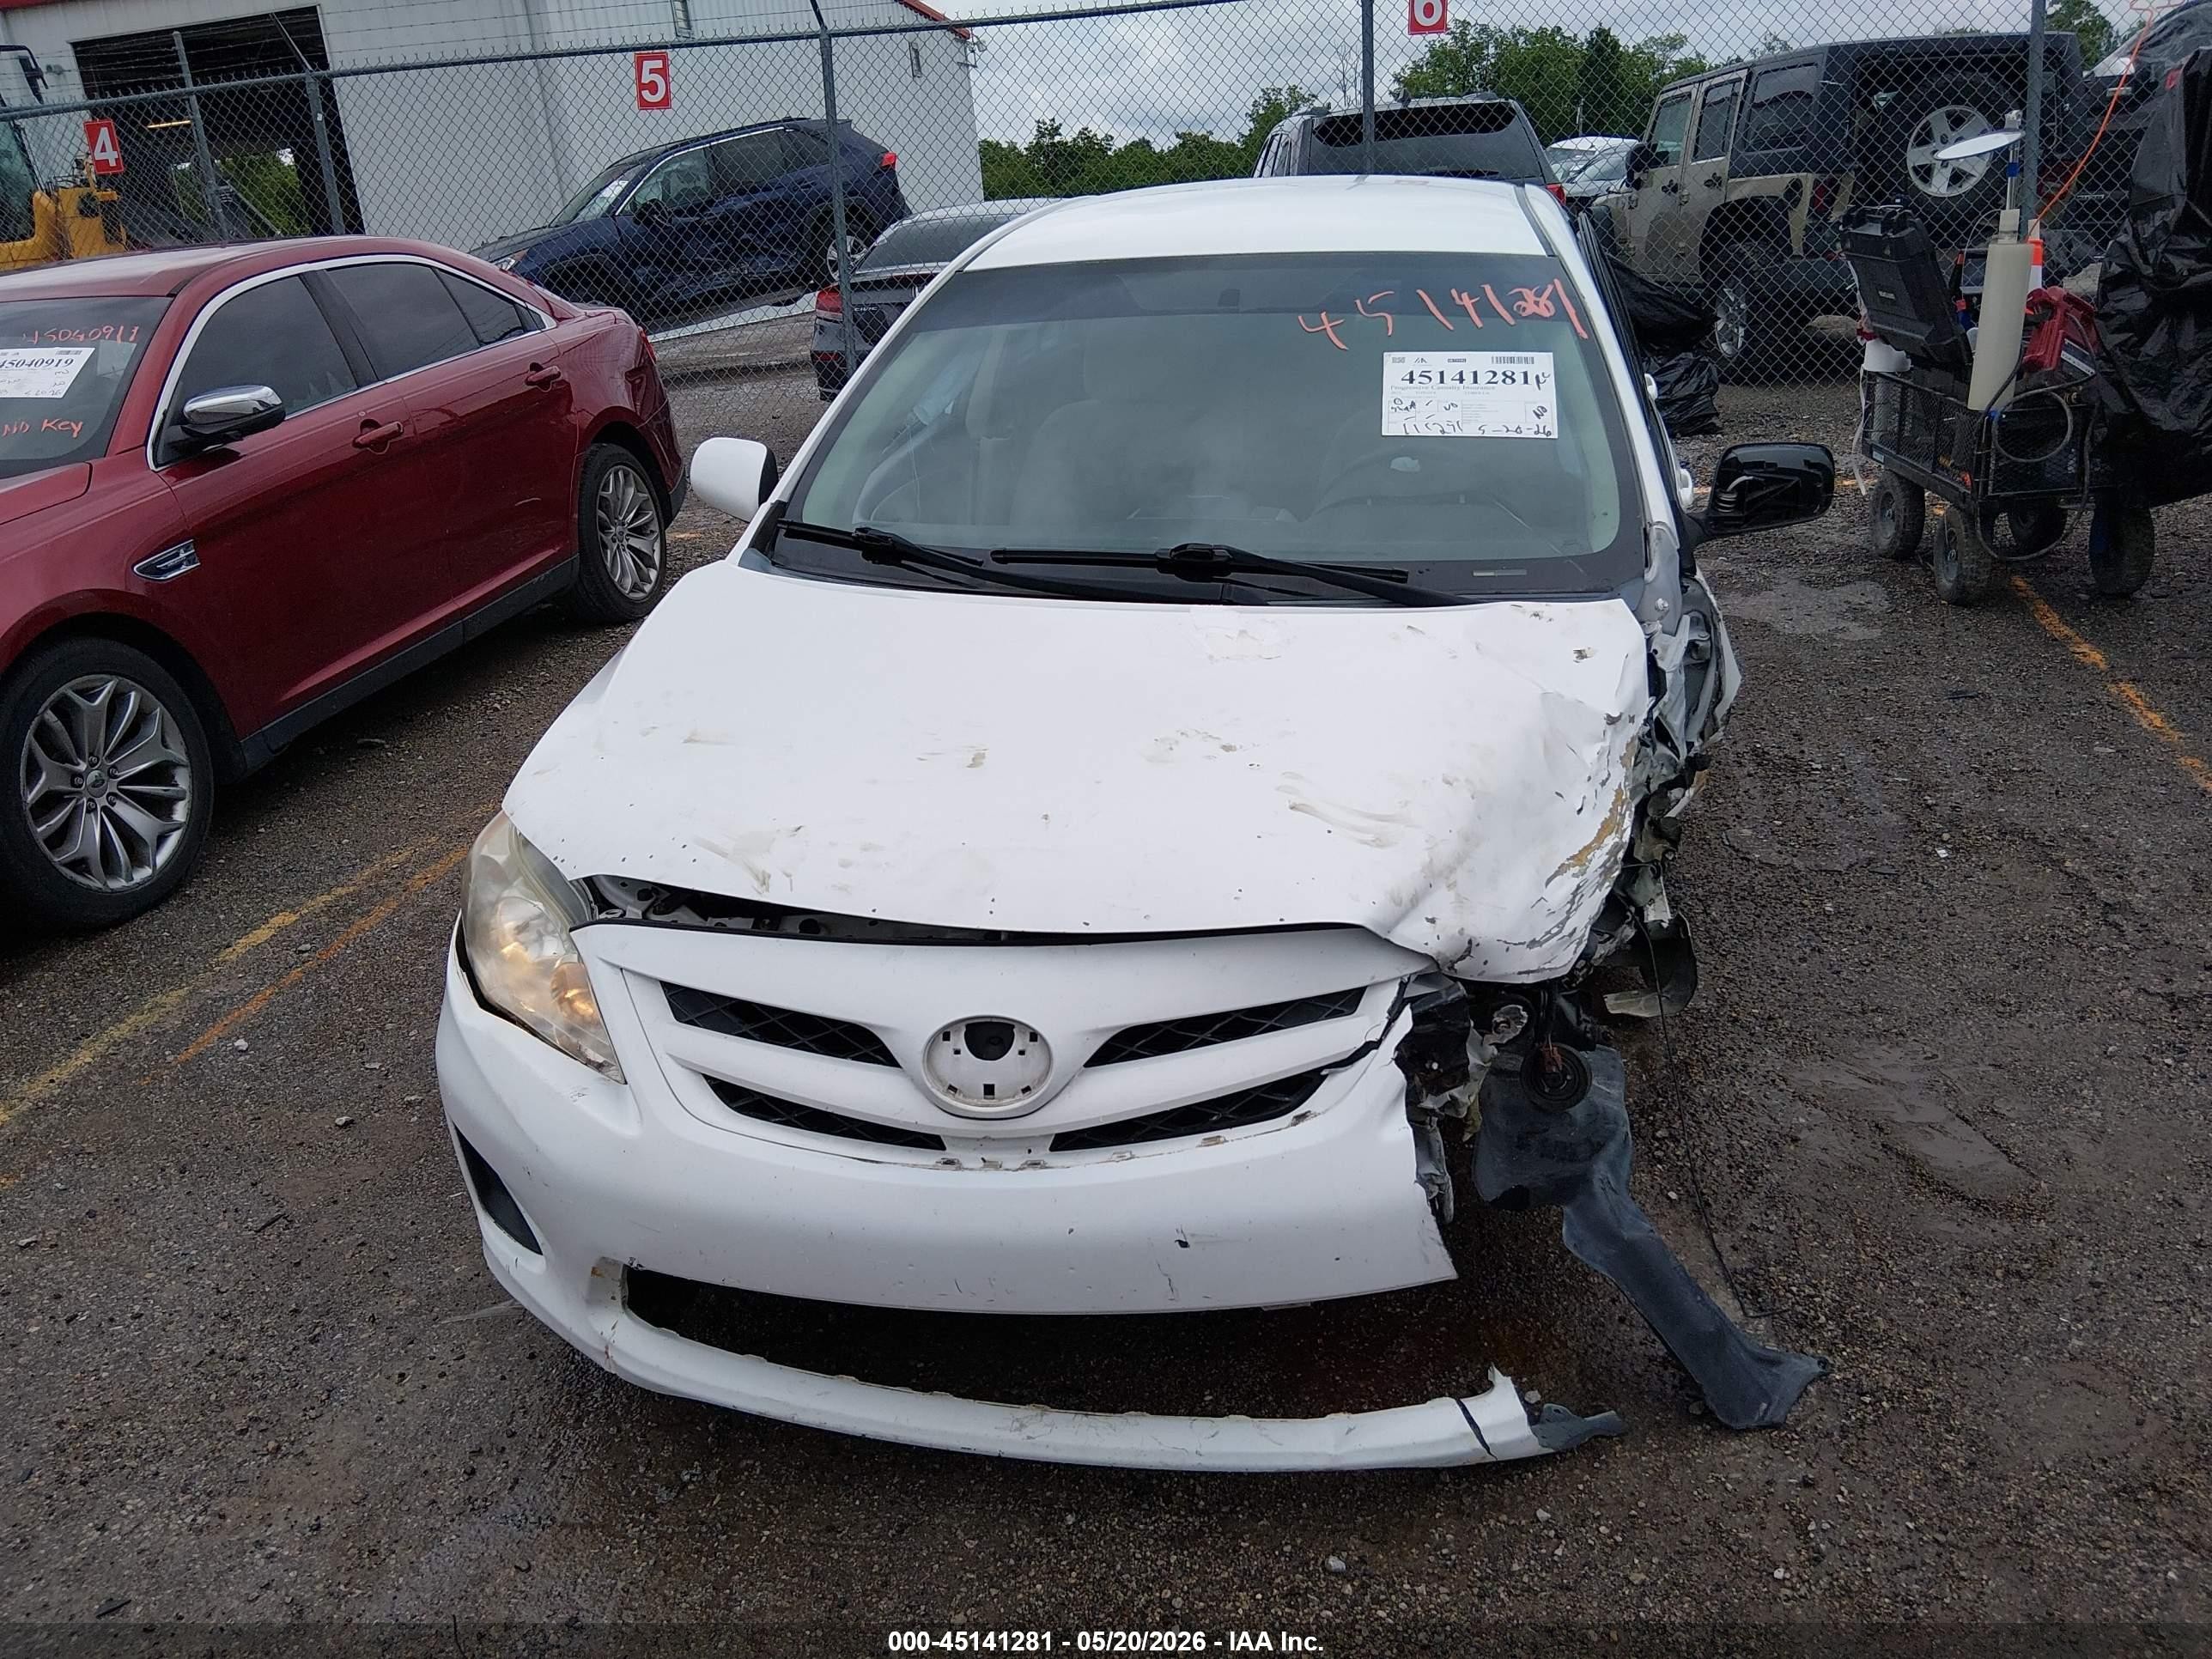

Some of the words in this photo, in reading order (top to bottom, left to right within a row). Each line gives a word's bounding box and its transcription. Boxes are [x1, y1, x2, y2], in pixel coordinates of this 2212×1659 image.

[641, 59, 665, 102] 5
[94, 126, 118, 167] 4
[1297, 277, 1588, 351] 45141281
[1401, 369, 1531, 385] 45141281
